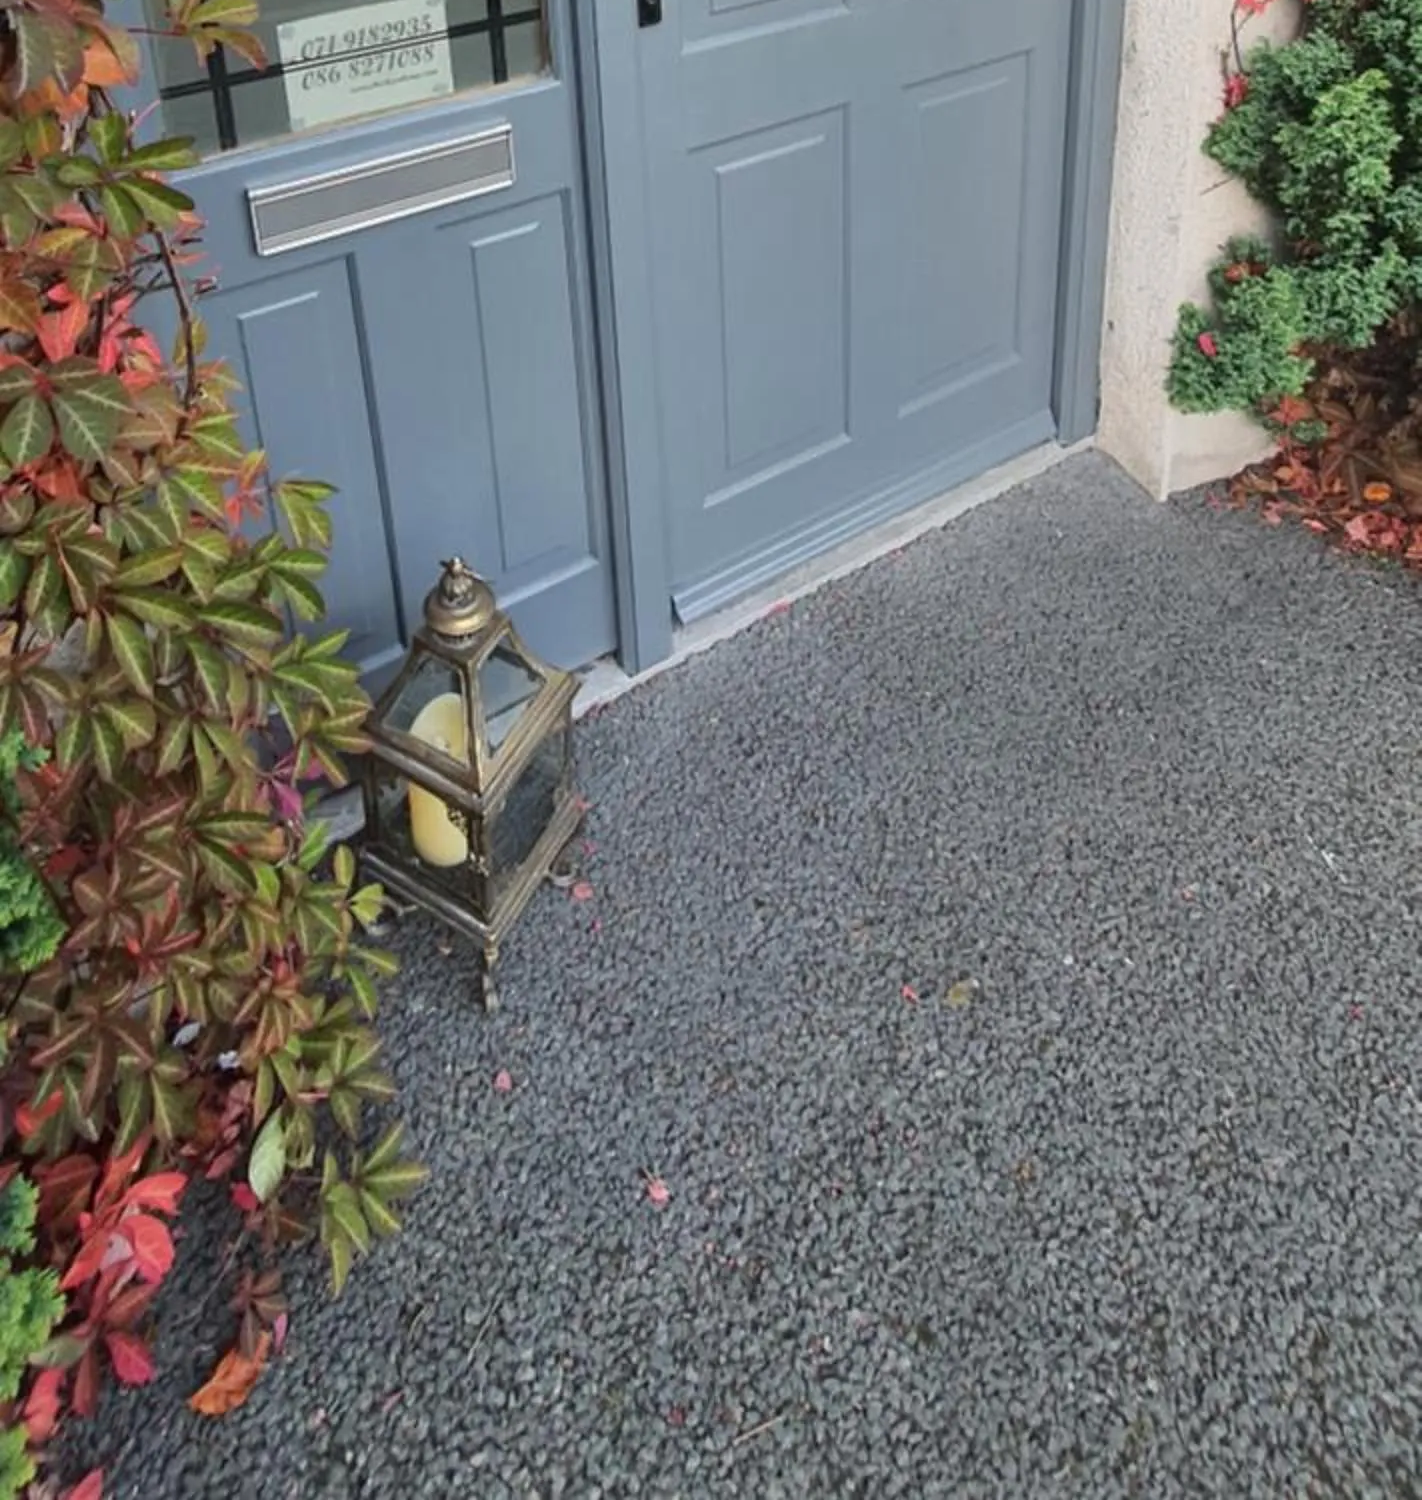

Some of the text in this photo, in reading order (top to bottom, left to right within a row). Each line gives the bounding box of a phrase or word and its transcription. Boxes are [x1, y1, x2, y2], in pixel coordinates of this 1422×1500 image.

[300, 13, 433, 61] 071 9182935
[302, 66, 342, 91] 086
[348, 43, 436, 79] 8271088
